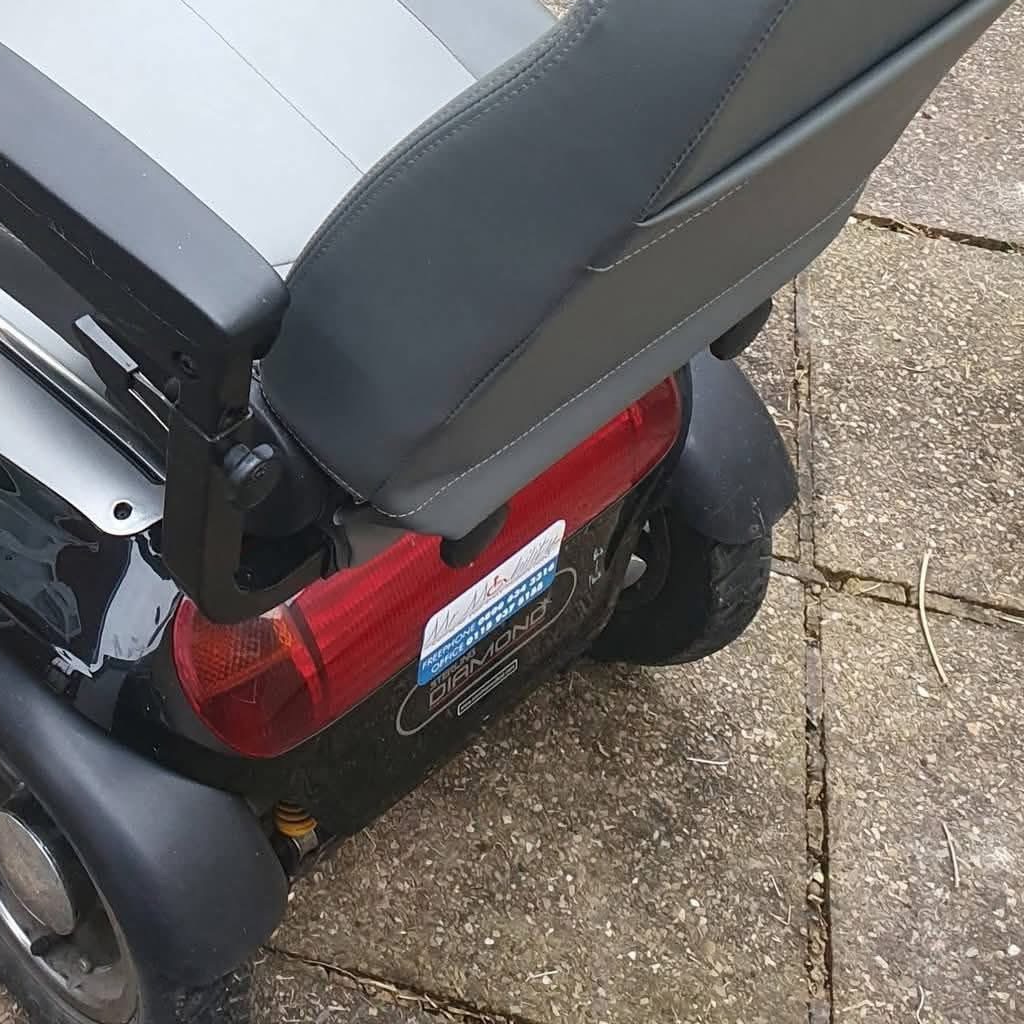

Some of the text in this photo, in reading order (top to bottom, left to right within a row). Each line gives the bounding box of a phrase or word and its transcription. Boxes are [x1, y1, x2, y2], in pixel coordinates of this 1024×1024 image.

[422, 622, 476, 670] FREEPHONE
[478, 601, 505, 626] 0800
[429, 603, 547, 708] DIAMOND
[431, 644, 465, 673] OFFICE
[466, 621, 493, 646] 0118
